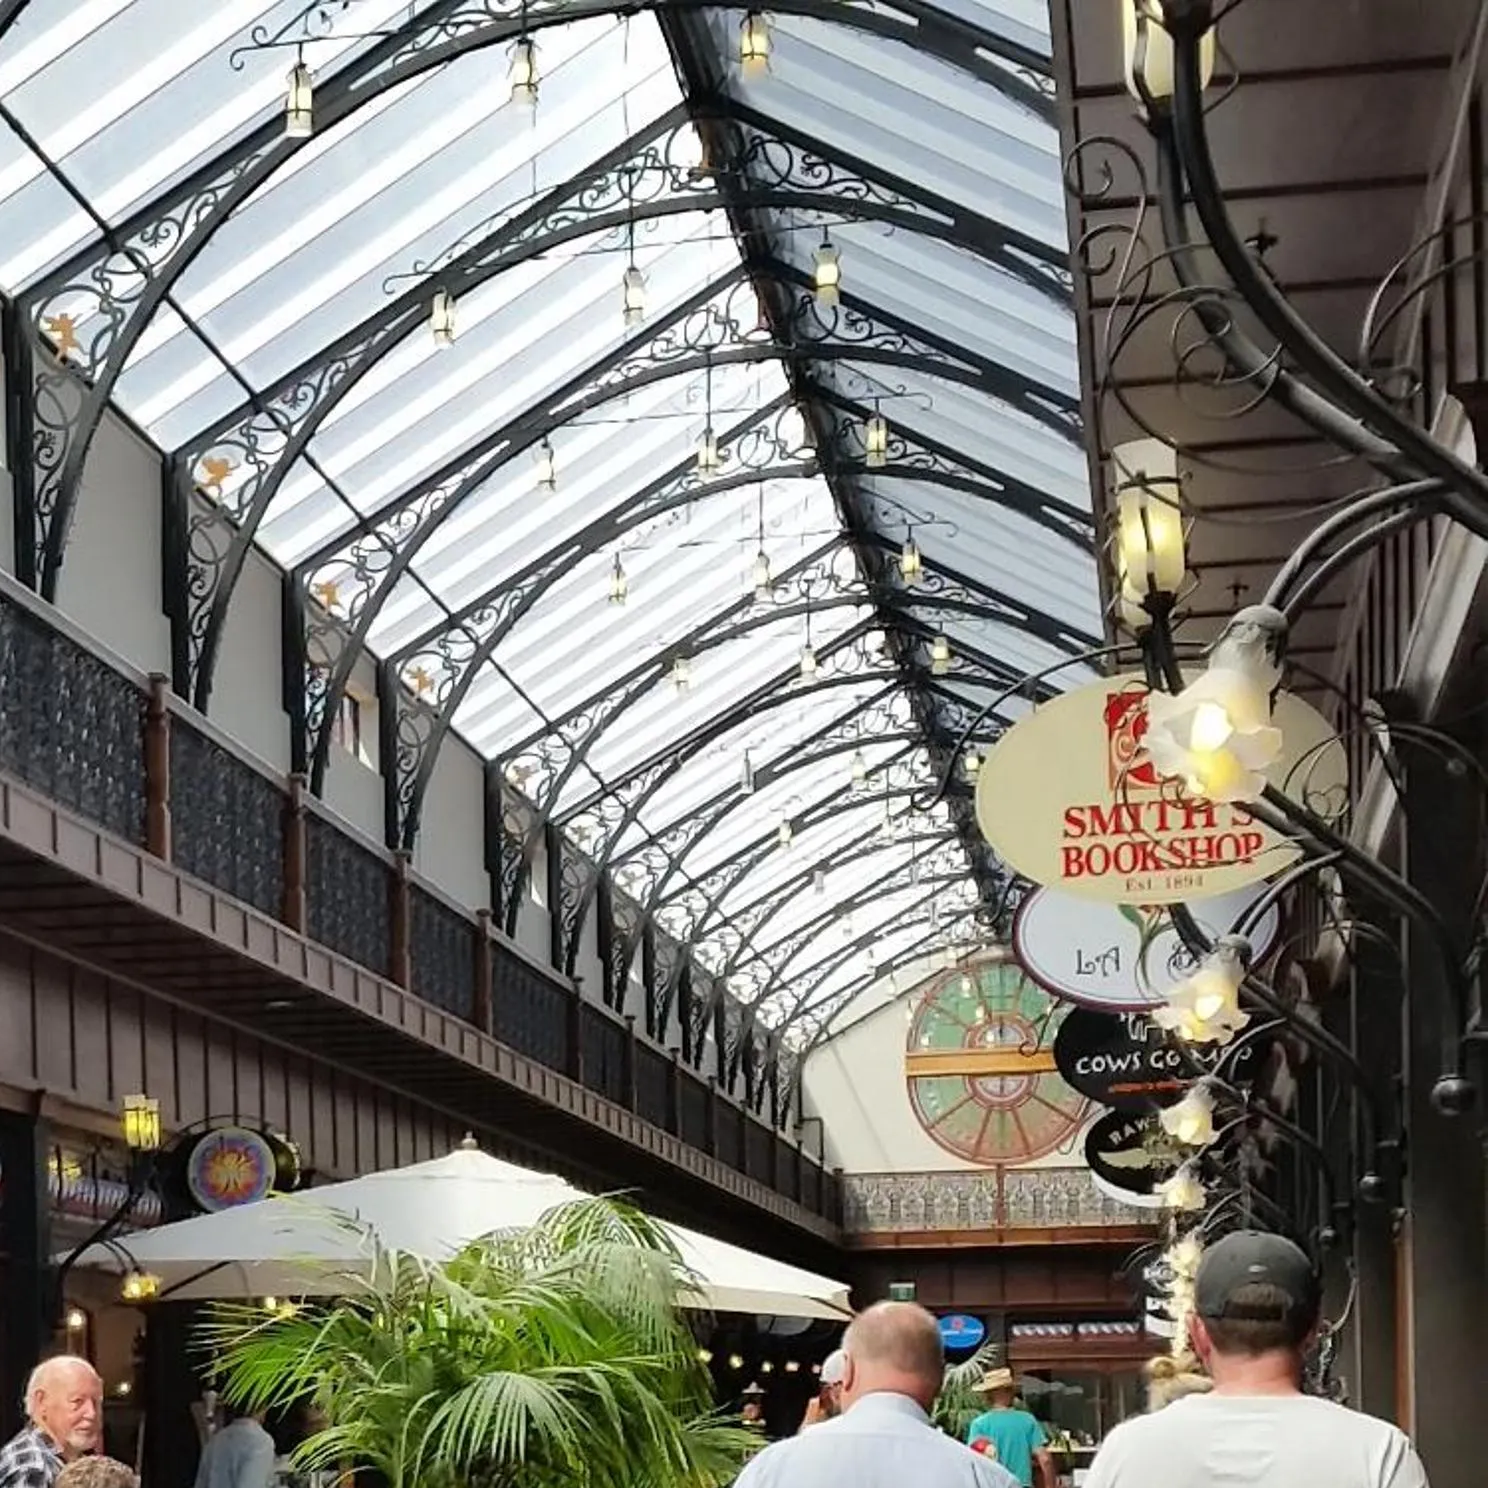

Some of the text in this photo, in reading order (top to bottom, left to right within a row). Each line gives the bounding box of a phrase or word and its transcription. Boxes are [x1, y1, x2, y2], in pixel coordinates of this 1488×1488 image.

[1063, 798, 1254, 839] SMITHS
[1061, 831, 1264, 878] BOOKSHOP
[1076, 946, 1121, 977] LA
[1075, 1051, 1141, 1075] COWS
